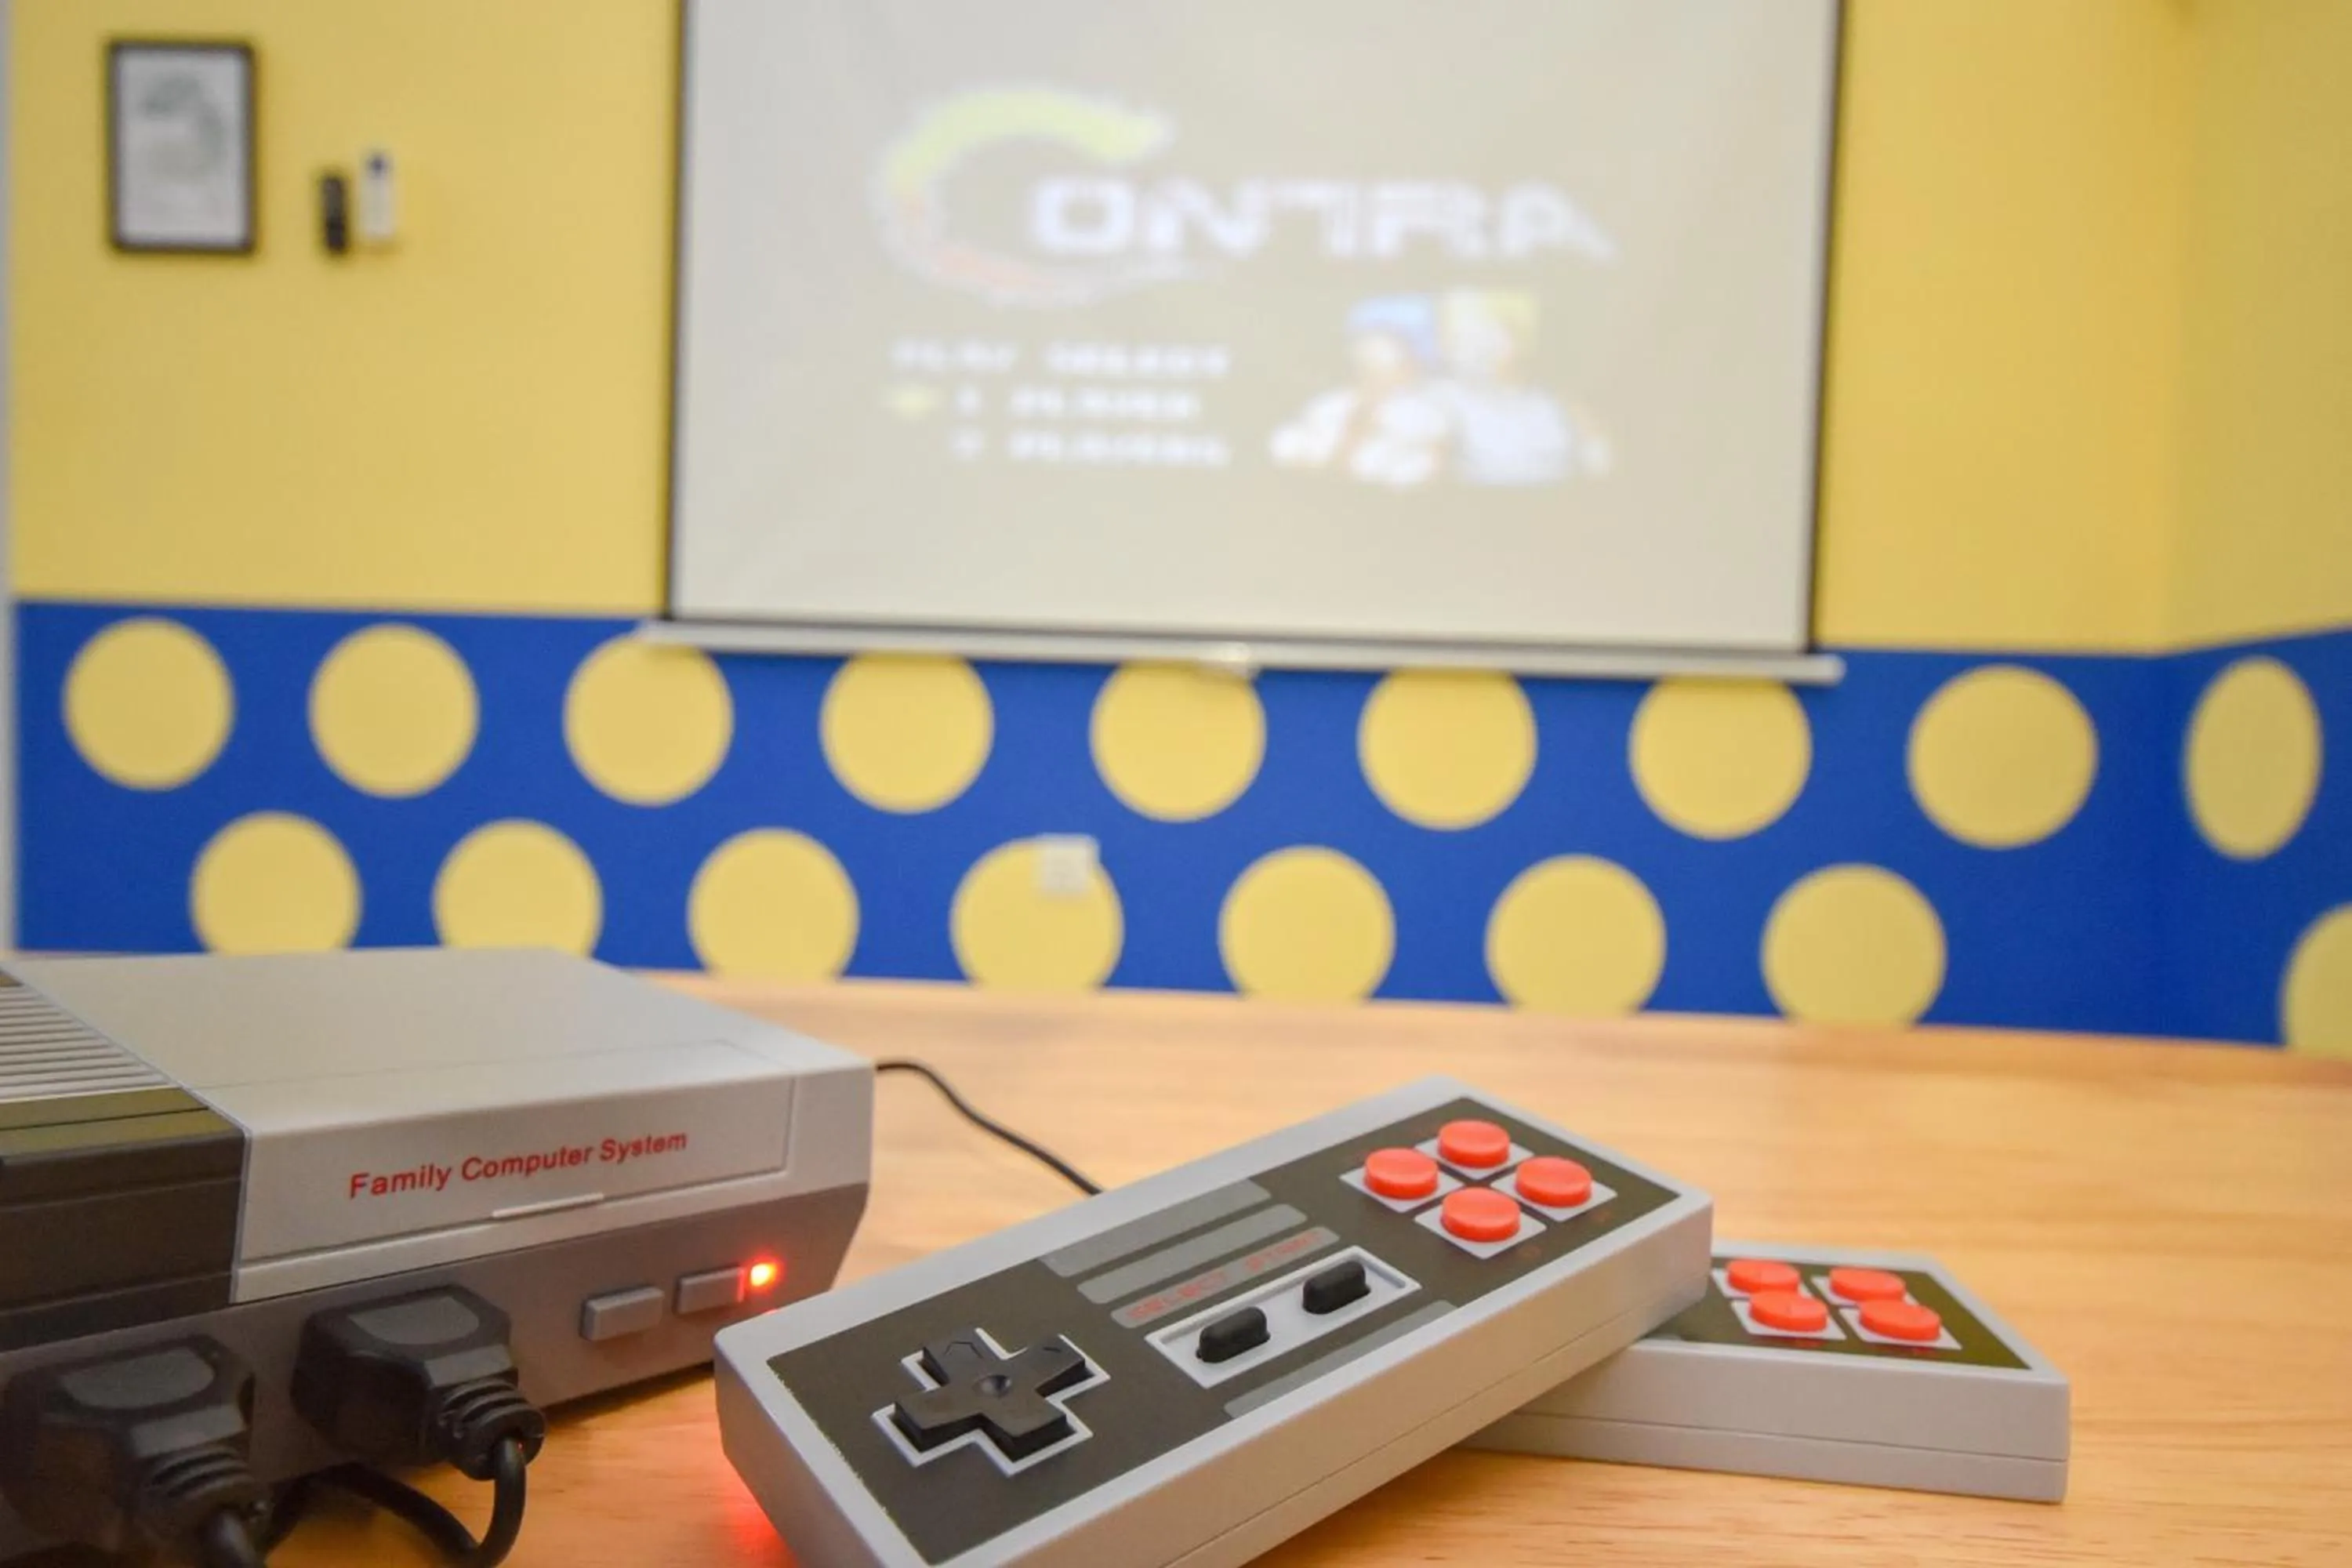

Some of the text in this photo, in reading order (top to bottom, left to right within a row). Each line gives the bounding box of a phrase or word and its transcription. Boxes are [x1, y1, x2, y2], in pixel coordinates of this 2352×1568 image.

[872, 82, 1617, 306] CONTRA
[349, 1132, 688, 1199] Family Computer System
